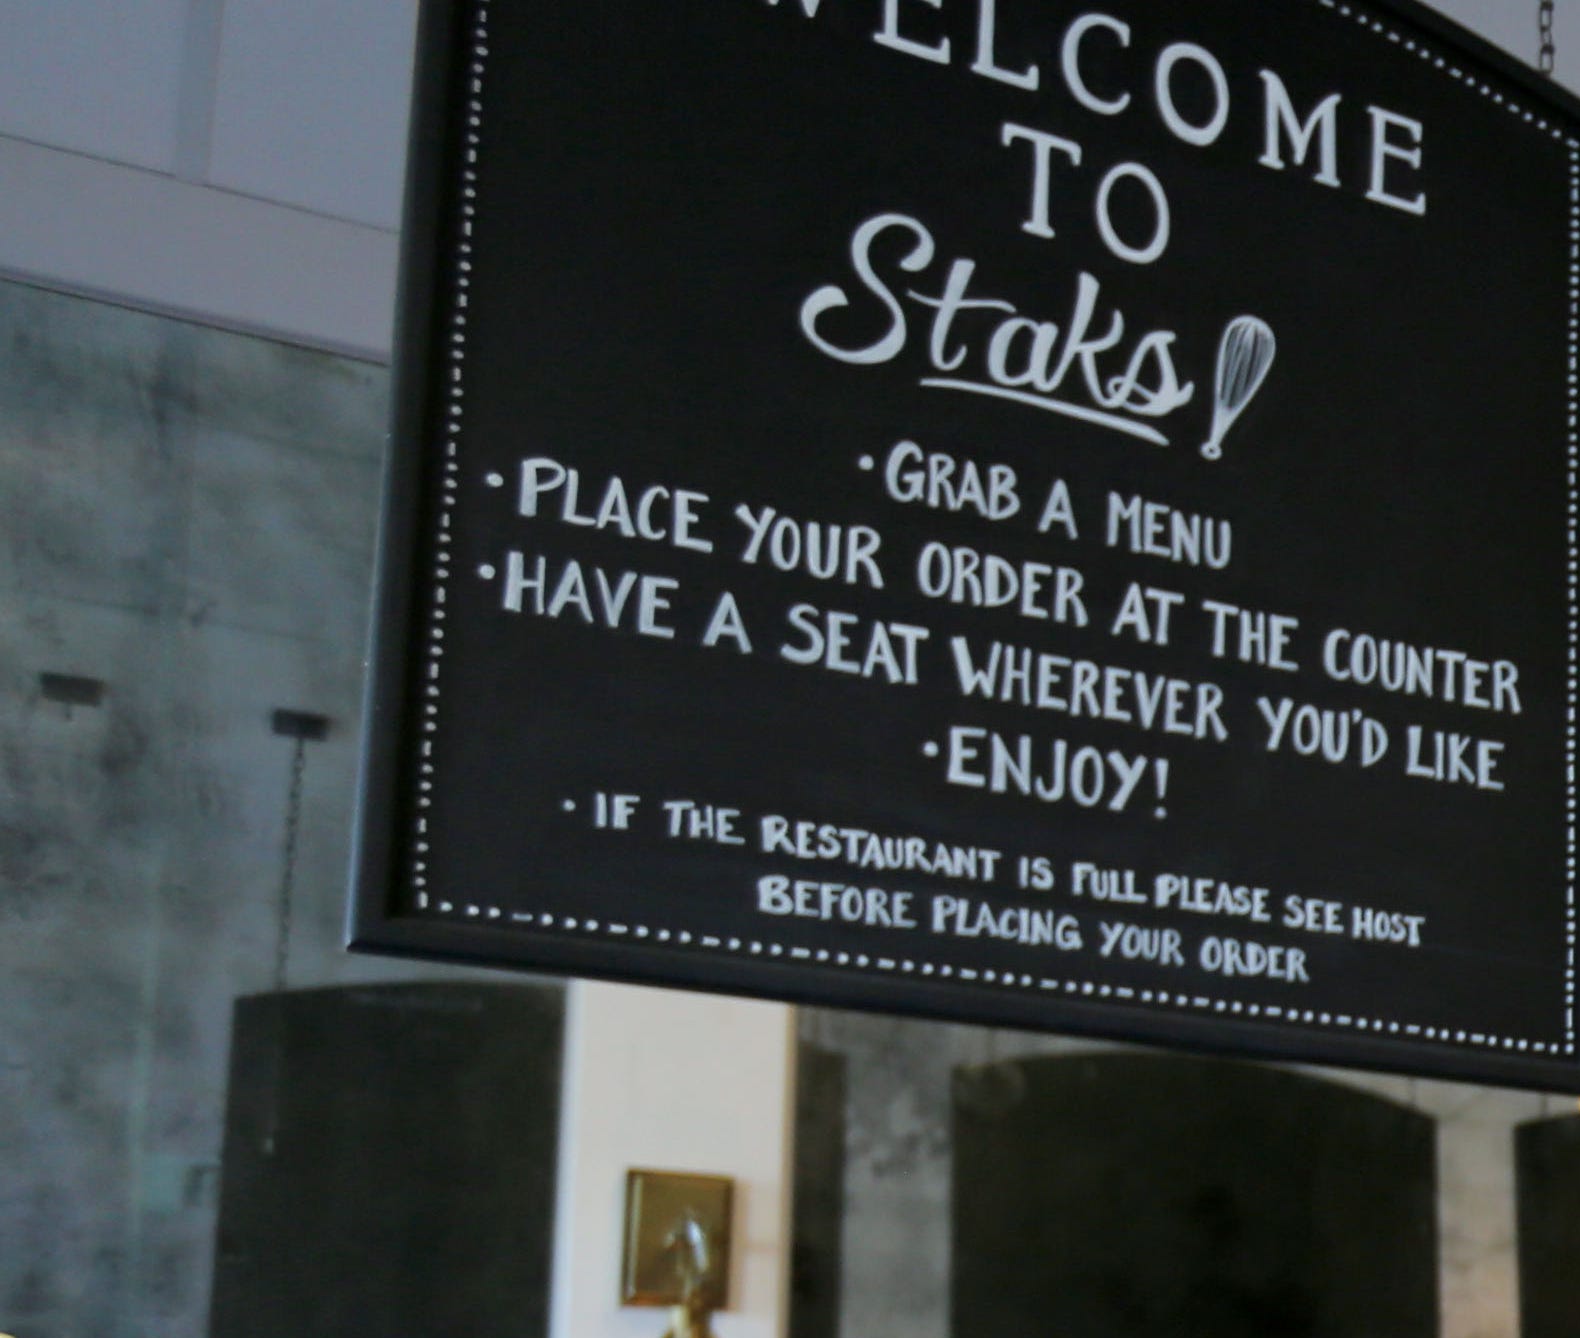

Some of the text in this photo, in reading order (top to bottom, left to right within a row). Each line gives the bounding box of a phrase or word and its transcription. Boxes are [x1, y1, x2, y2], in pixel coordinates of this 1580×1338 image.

[769, 0, 1426, 214] ELCOME
[1002, 123, 1169, 263] TO
[886, 441, 1230, 568] GRAB A MENU
[520, 458, 1520, 722] PLACE YOUR ORDER AT THE COUNTER
[504, 551, 1504, 789] HAVE A SEAT WHEREVER YOU'D LIKE
[948, 726, 1168, 818] ENJOY!
[596, 793, 1425, 946] IF THE RESTAURANT IS FULL PLEASE SEE HOST
[758, 875, 1308, 981] BEFORE PLACING YOUR ORDER
